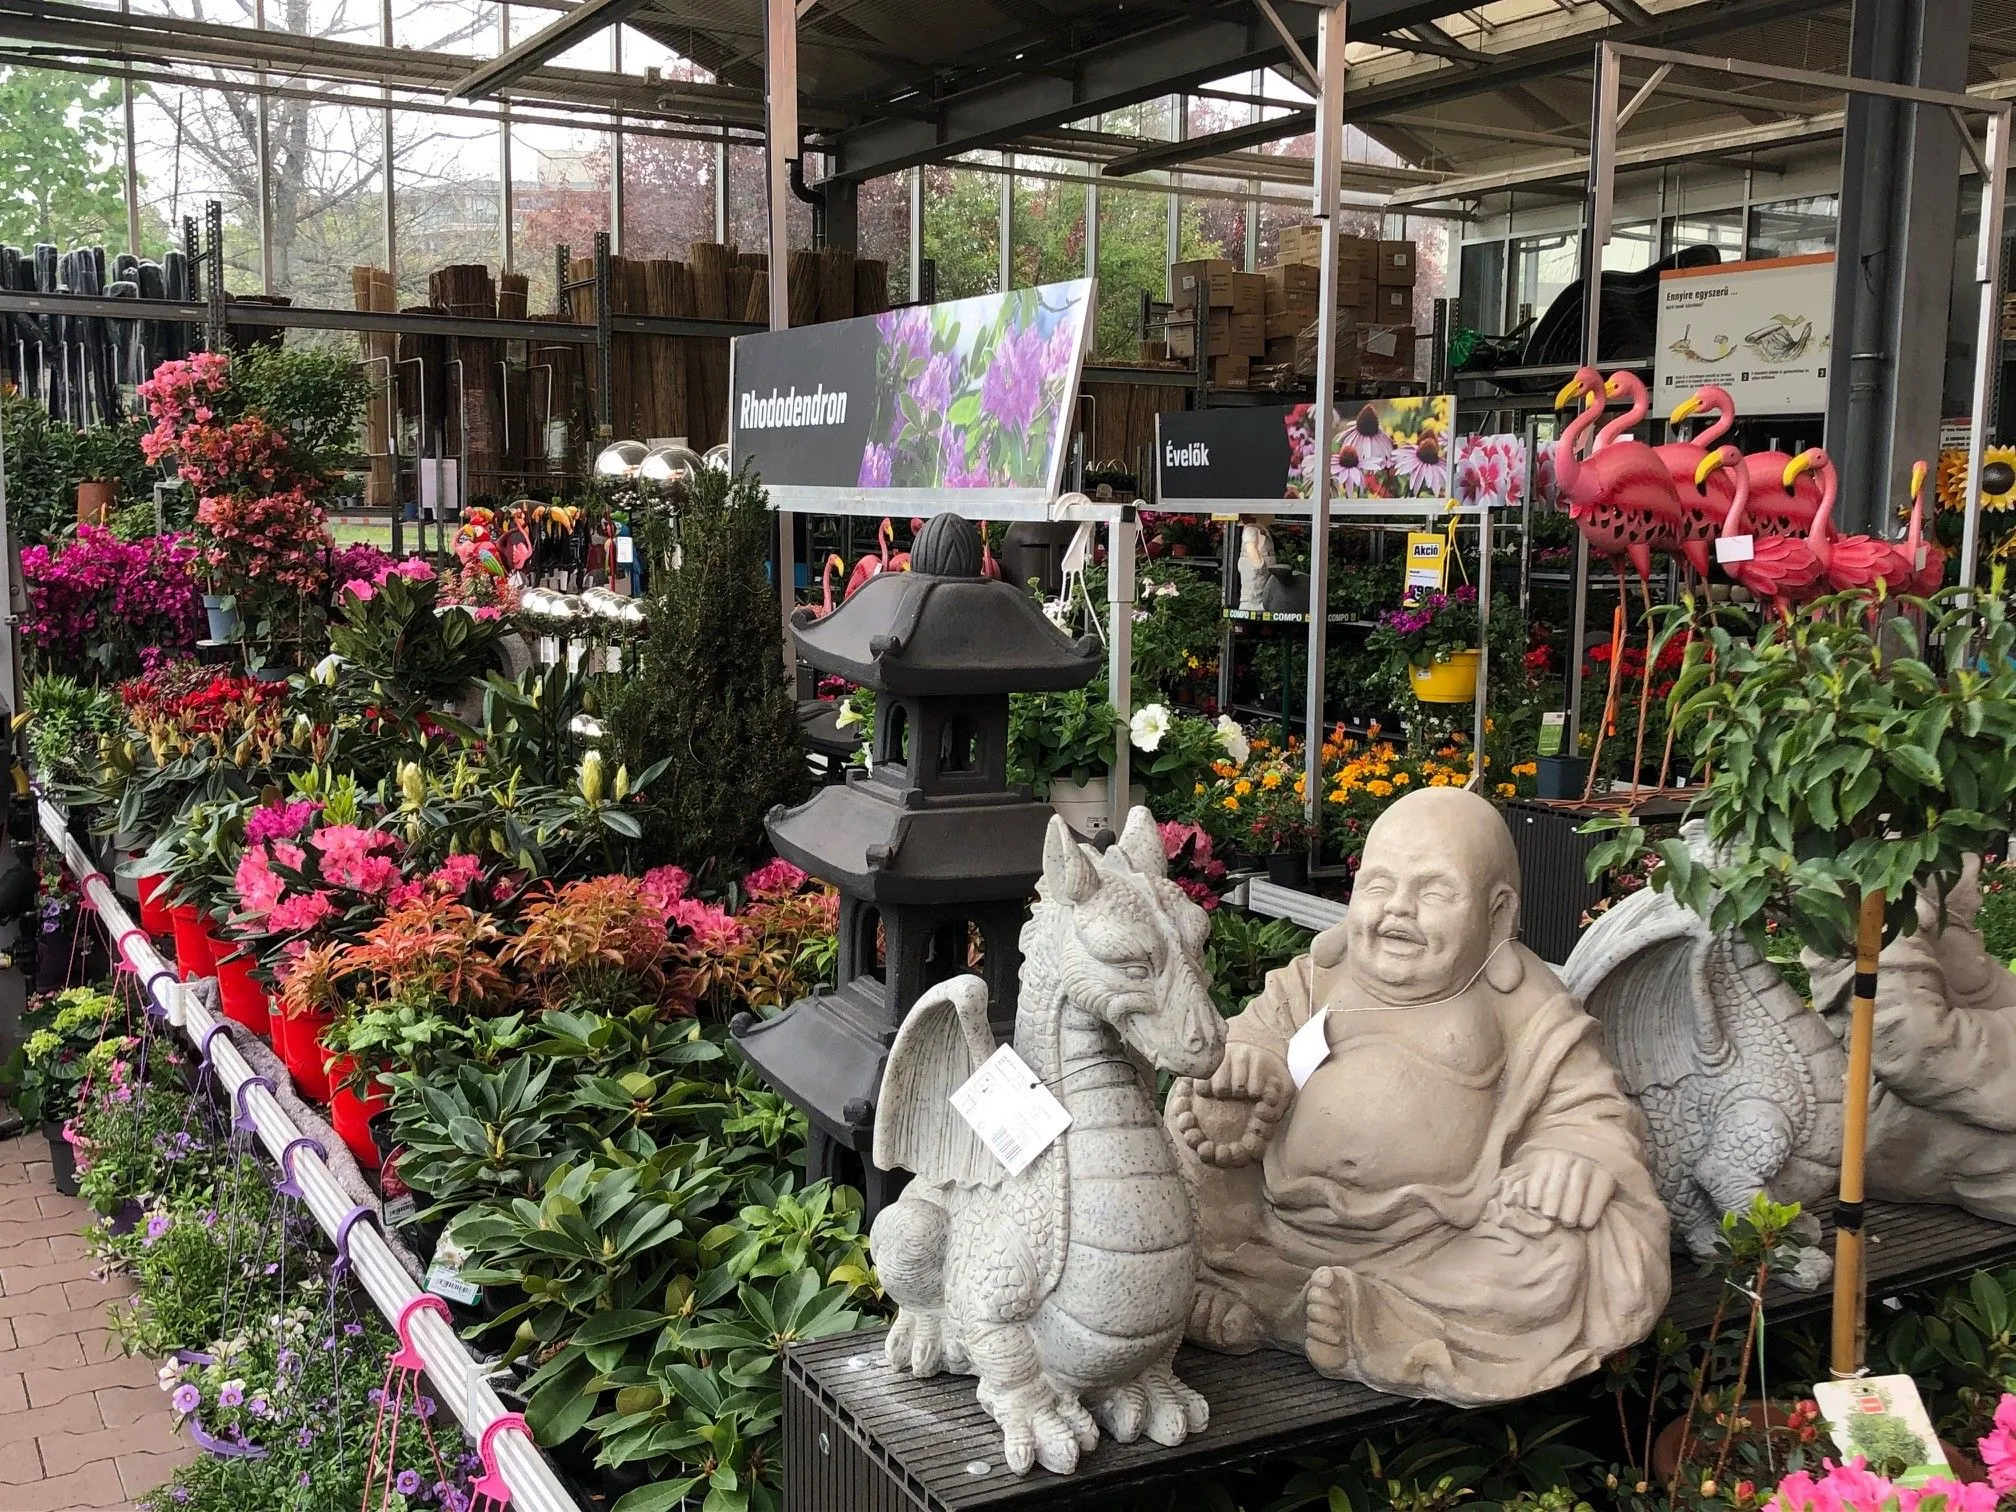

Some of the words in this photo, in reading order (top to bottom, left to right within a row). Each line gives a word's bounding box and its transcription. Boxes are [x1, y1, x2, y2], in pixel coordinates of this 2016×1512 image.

[1666, 291, 1693, 302] Ennyire
[1695, 286, 1729, 300] egyszerű
[740, 383, 847, 429] Rhododendron
[1166, 440, 1210, 467] Évelők
[1414, 545, 1438, 556] Akció
[1230, 611, 1249, 619] COMPO
[1273, 613, 1302, 622] COMPO
[1328, 613, 1349, 622] COMPO
